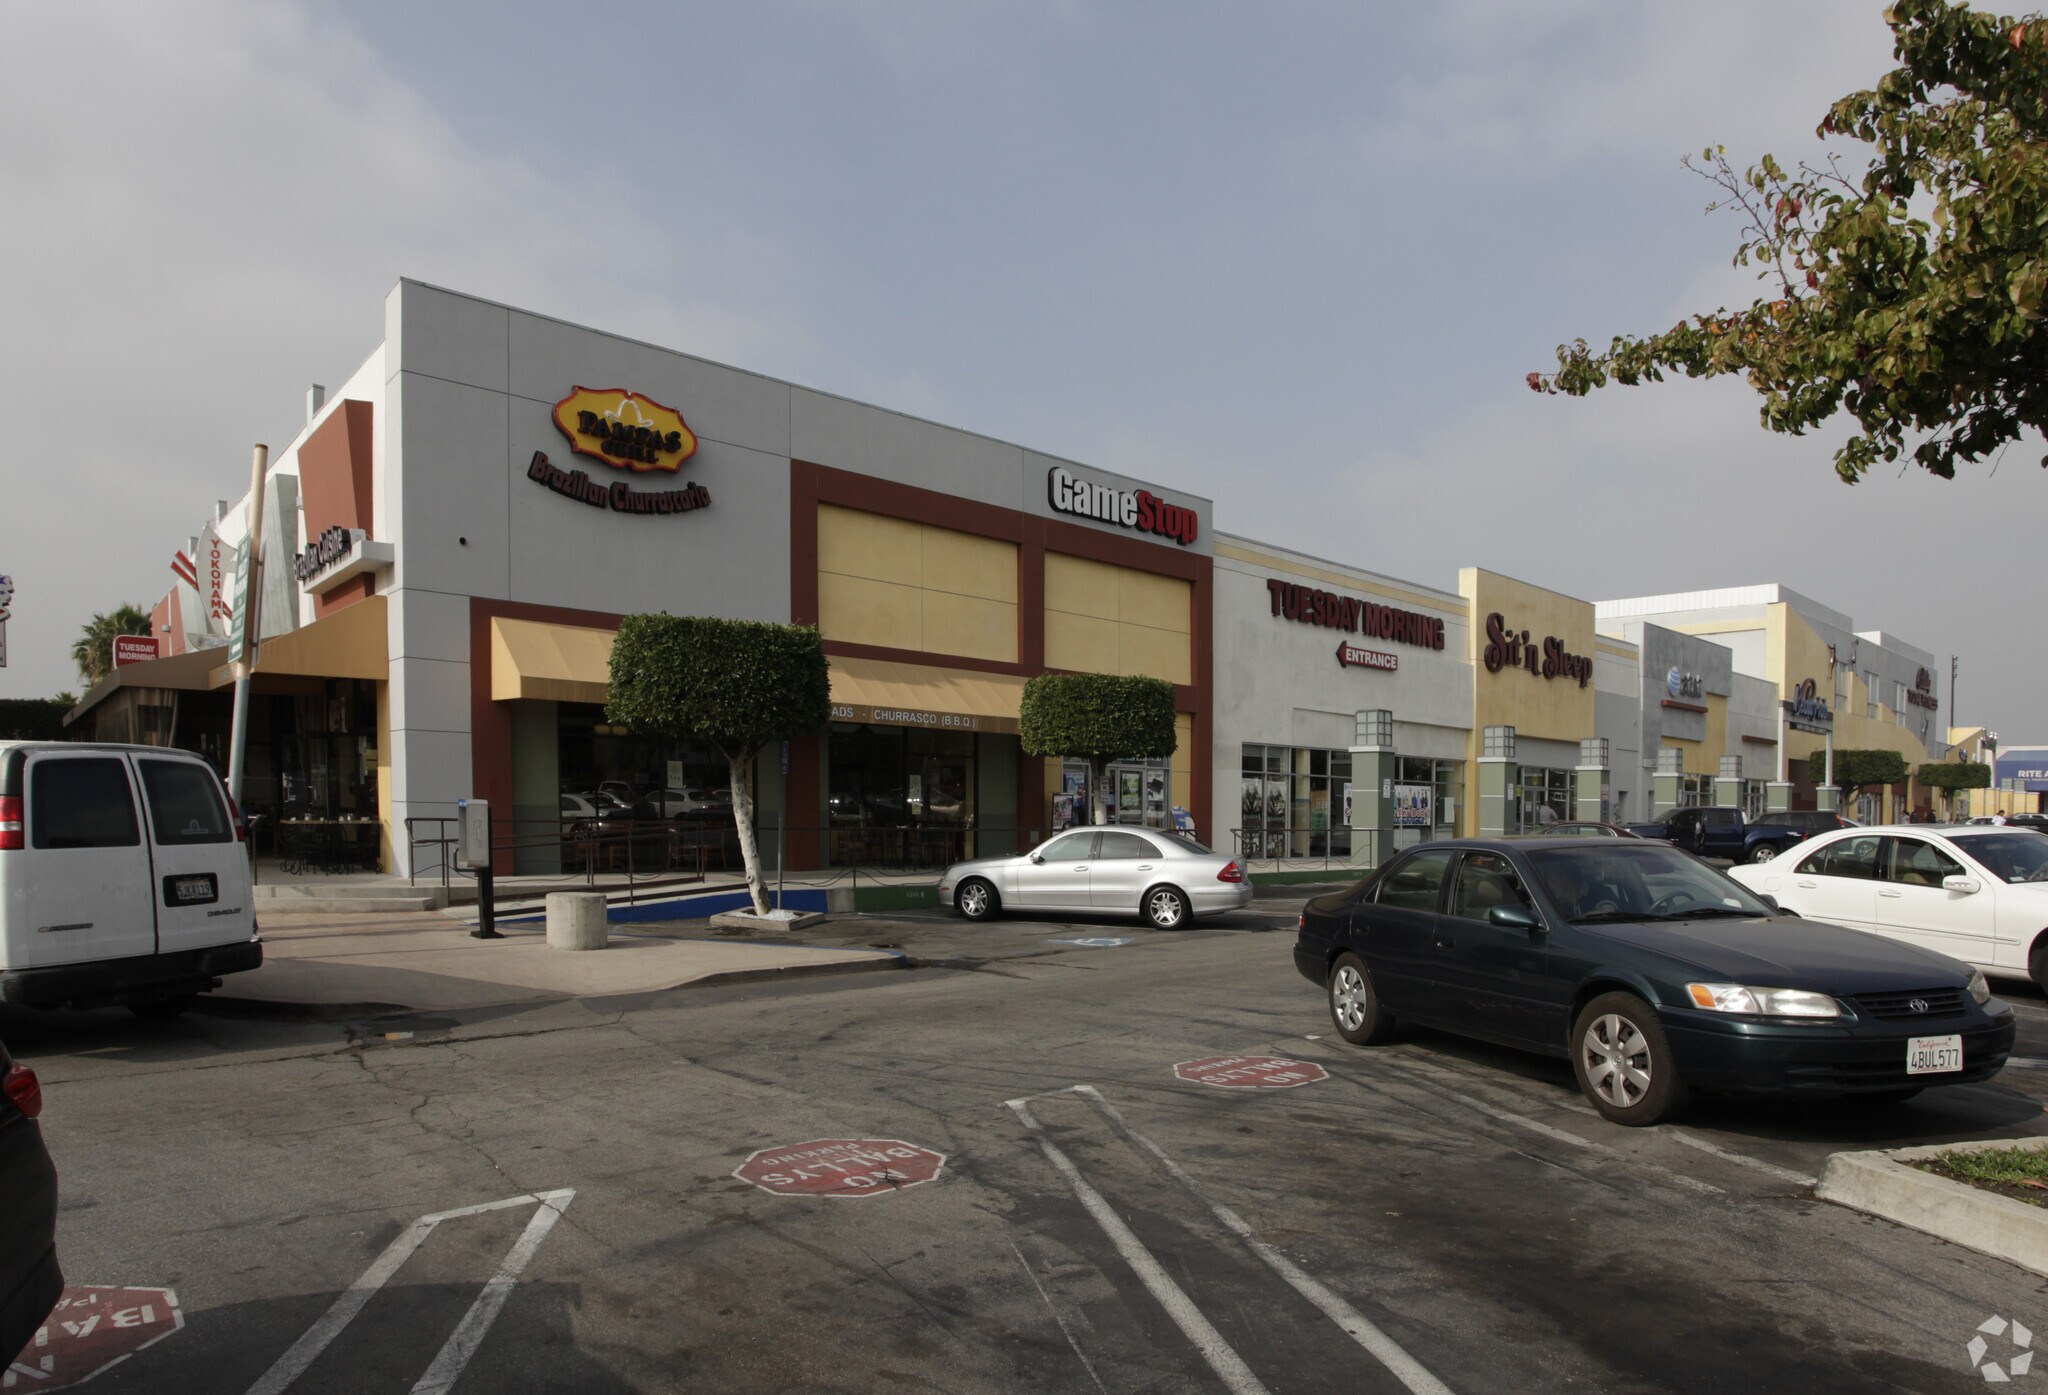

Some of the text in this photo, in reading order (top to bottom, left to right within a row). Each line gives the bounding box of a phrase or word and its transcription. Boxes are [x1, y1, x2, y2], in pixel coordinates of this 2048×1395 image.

[577, 409, 682, 453] PAMPAS
[527, 450, 712, 514] Brazilian Churrascaria
[1048, 466, 1198, 546] GameStop
[210, 539, 221, 619] YOKOHAMA
[1267, 578, 1445, 651] TUESDAY MORNING
[119, 642, 156, 661] TUESDAY MORNING
[1345, 648, 1397, 669] ENTRANCE
[1542, 635, 1593, 688] Sleep
[831, 706, 853, 718] ADS
[874, 710, 936, 724] CHURRASCO
[2018, 770, 2042, 778] RITE
[1919, 1040, 1950, 1050] California
[1911, 1048, 1959, 1069] 4BUL577
[1263, 1071, 1308, 1083] NO
[761, 1142, 861, 1166] PARKING
[760, 1147, 922, 1185] BALLYS
[843, 1168, 909, 1188] NO
